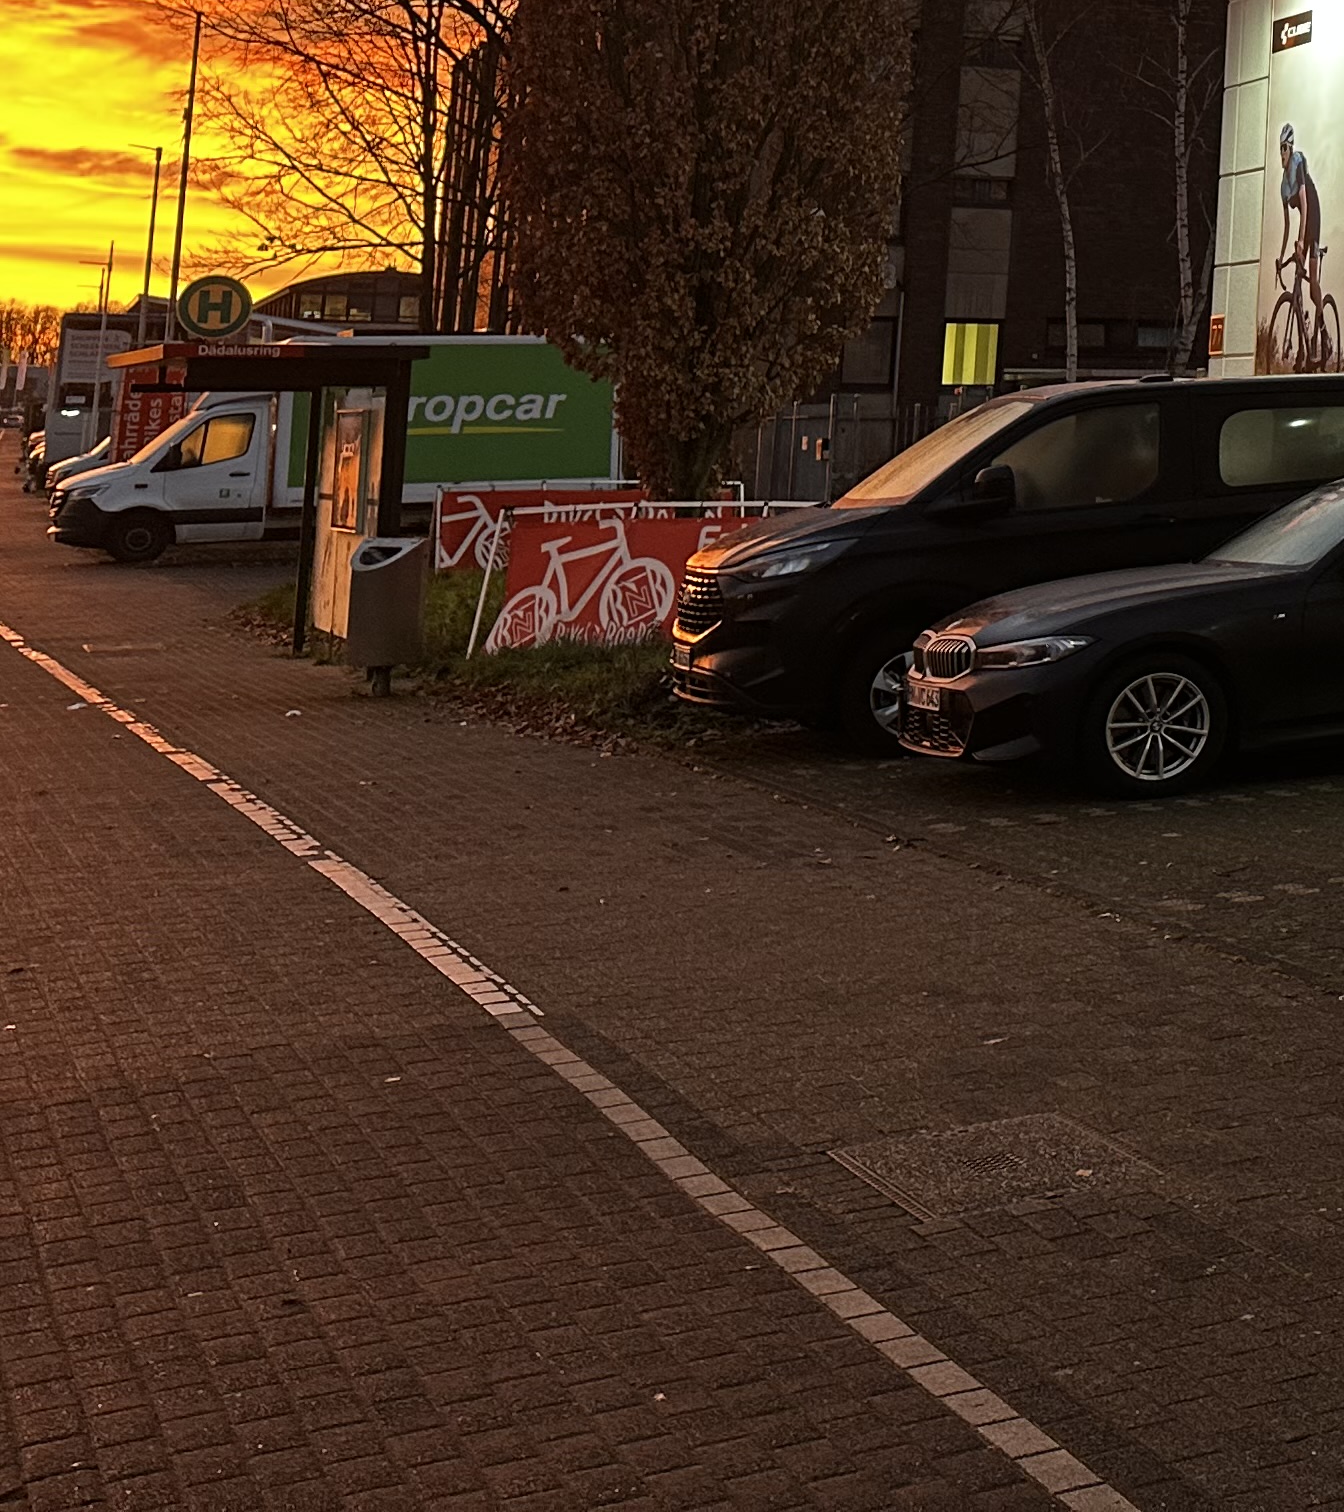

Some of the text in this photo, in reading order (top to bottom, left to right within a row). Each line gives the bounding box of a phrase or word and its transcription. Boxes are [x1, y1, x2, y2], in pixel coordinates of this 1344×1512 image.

[197, 289, 233, 324] H
[198, 341, 281, 358] Dädalusring
[407, 393, 568, 435] ropcar
